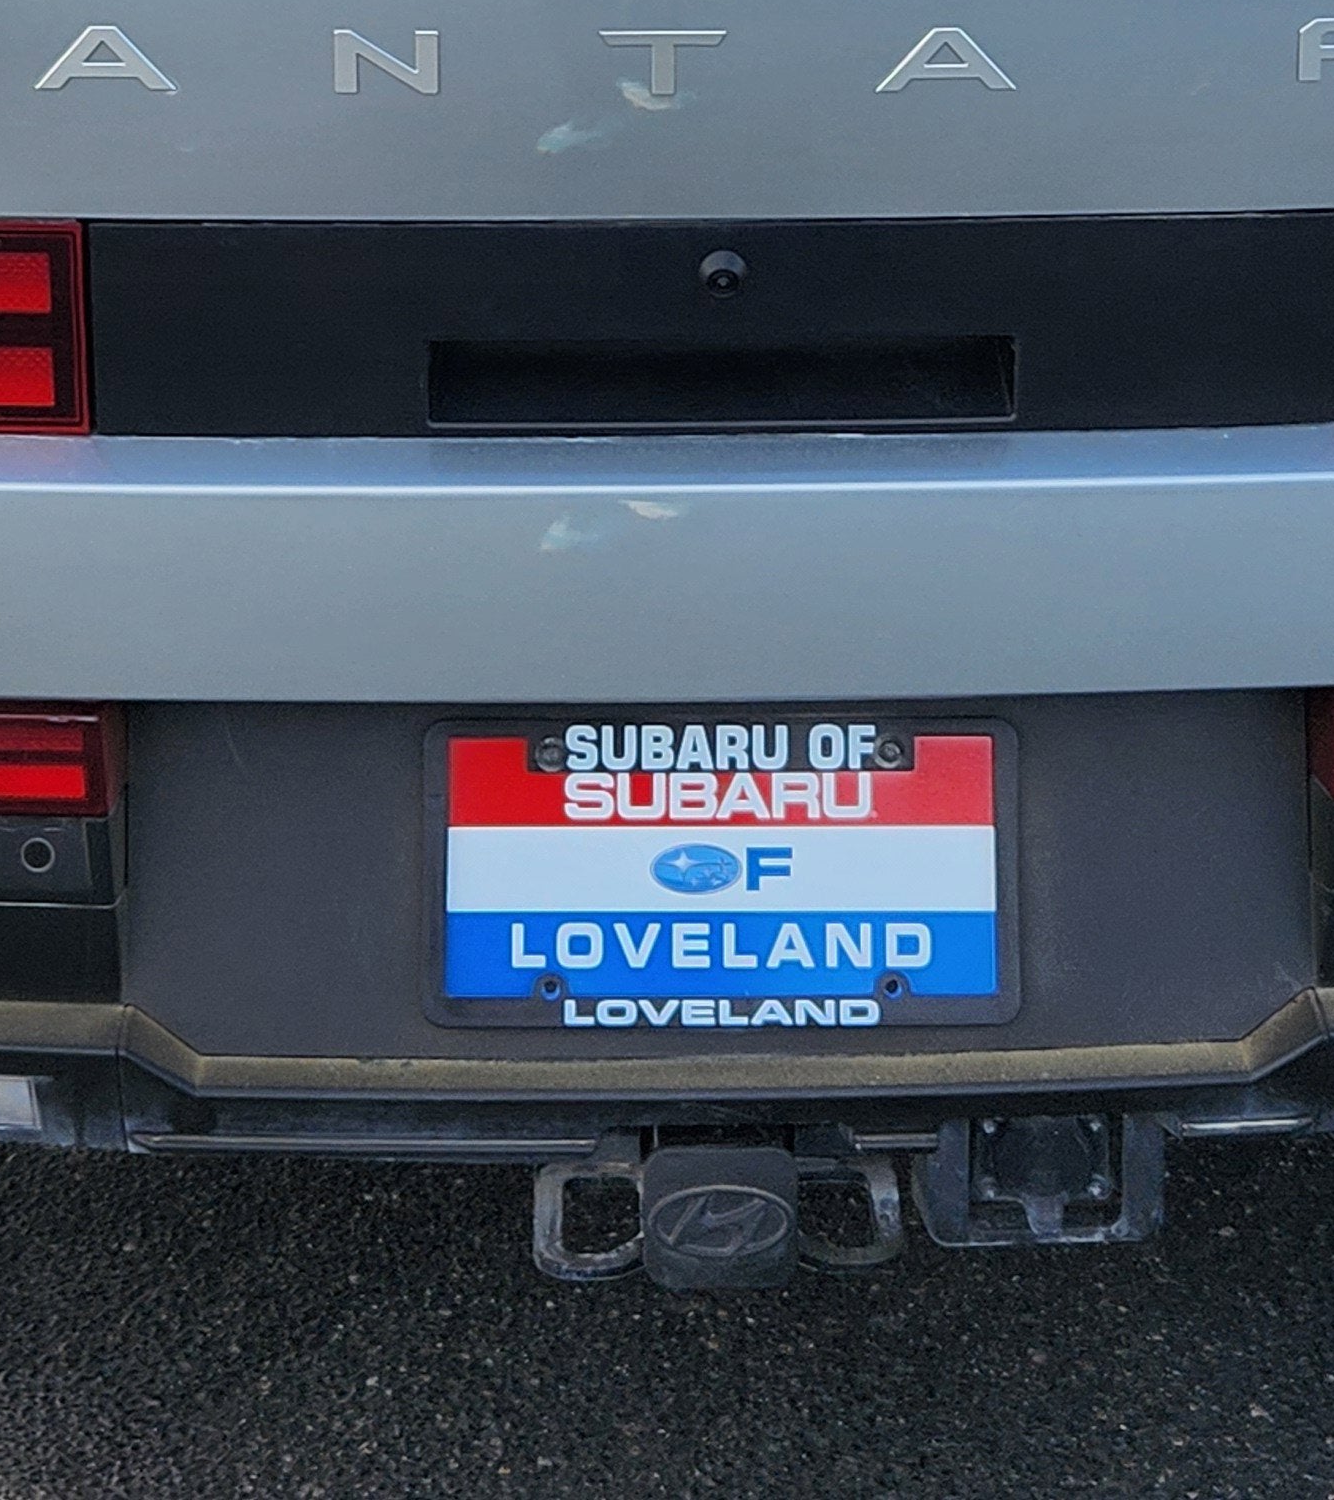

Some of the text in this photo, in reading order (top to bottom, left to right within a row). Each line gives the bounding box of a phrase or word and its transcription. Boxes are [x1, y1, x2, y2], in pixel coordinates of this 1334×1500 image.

[565, 723, 876, 771] SUBARU OF
[563, 771, 872, 820] SUBARU
[510, 922, 932, 969] LOVELAND
[563, 999, 880, 1026] LOVELAND
